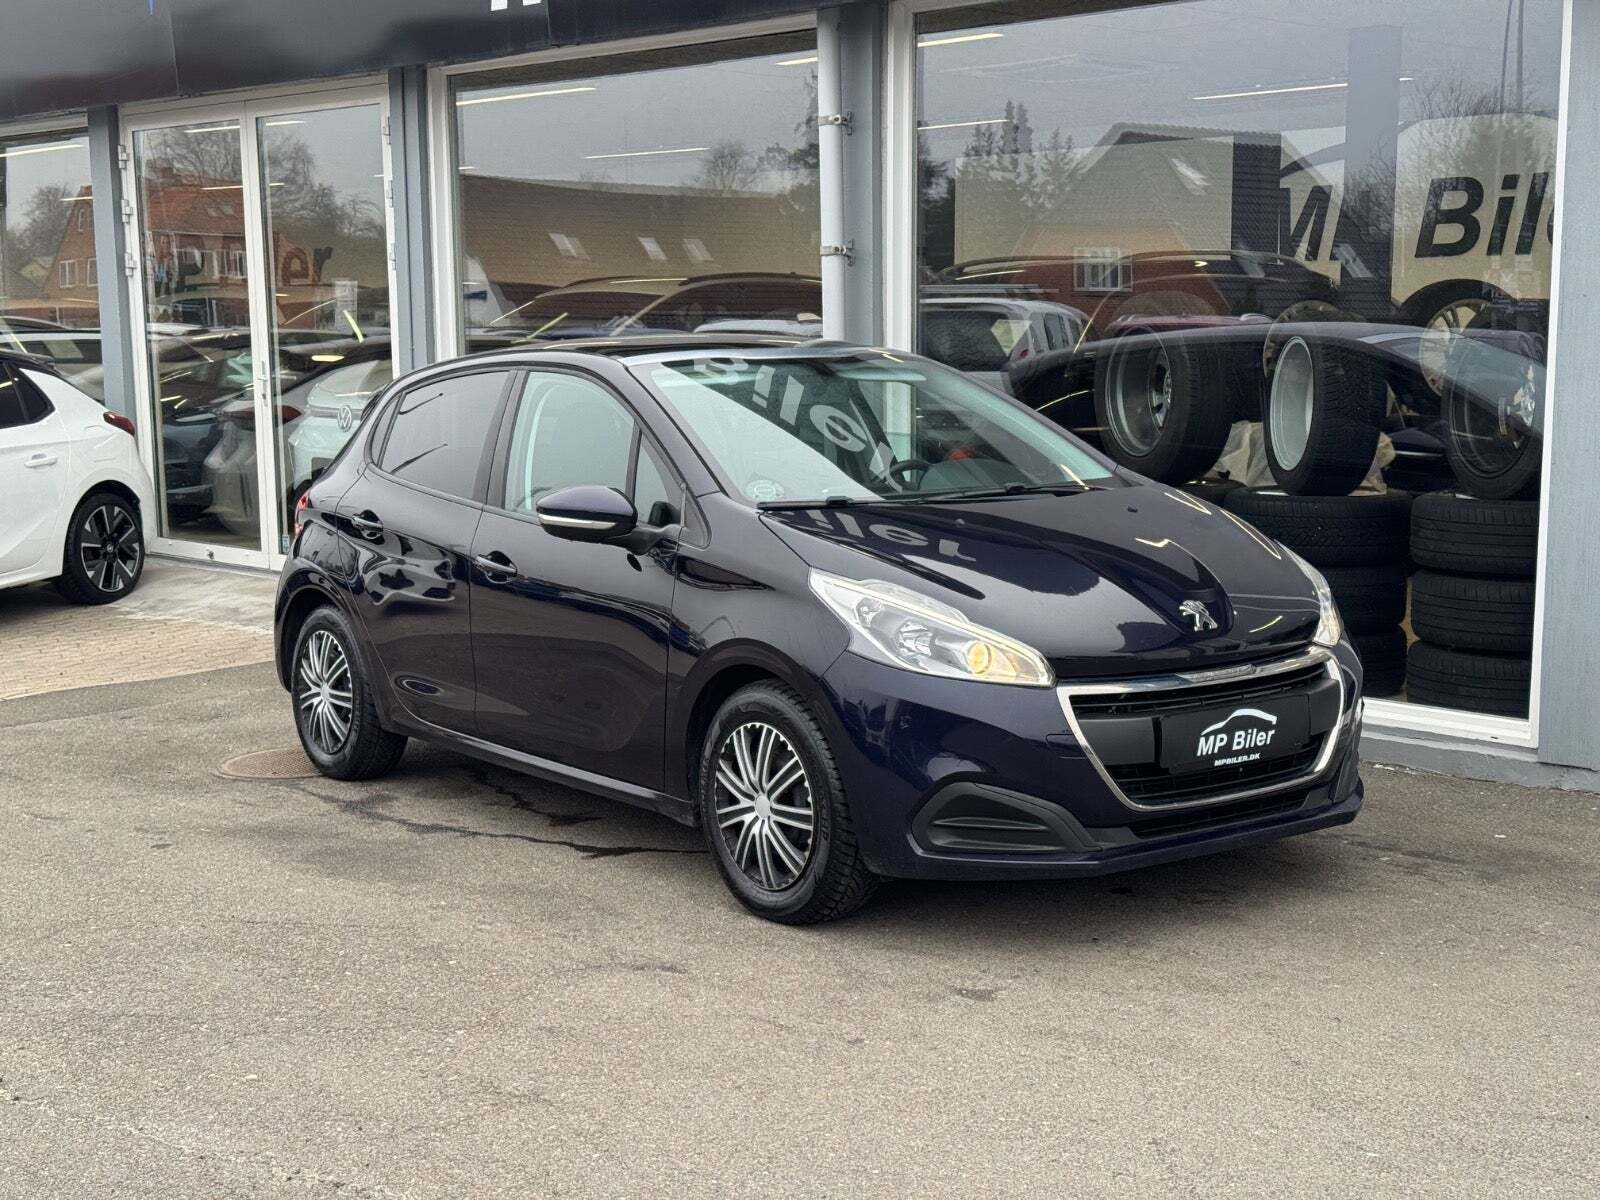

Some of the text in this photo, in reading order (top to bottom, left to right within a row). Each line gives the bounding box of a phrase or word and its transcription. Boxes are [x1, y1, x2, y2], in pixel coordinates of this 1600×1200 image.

[1414, 172, 1554, 259] Bil
[1196, 727, 1276, 757] MP Biler
[1214, 752, 1261, 767] MPBILER.DK
